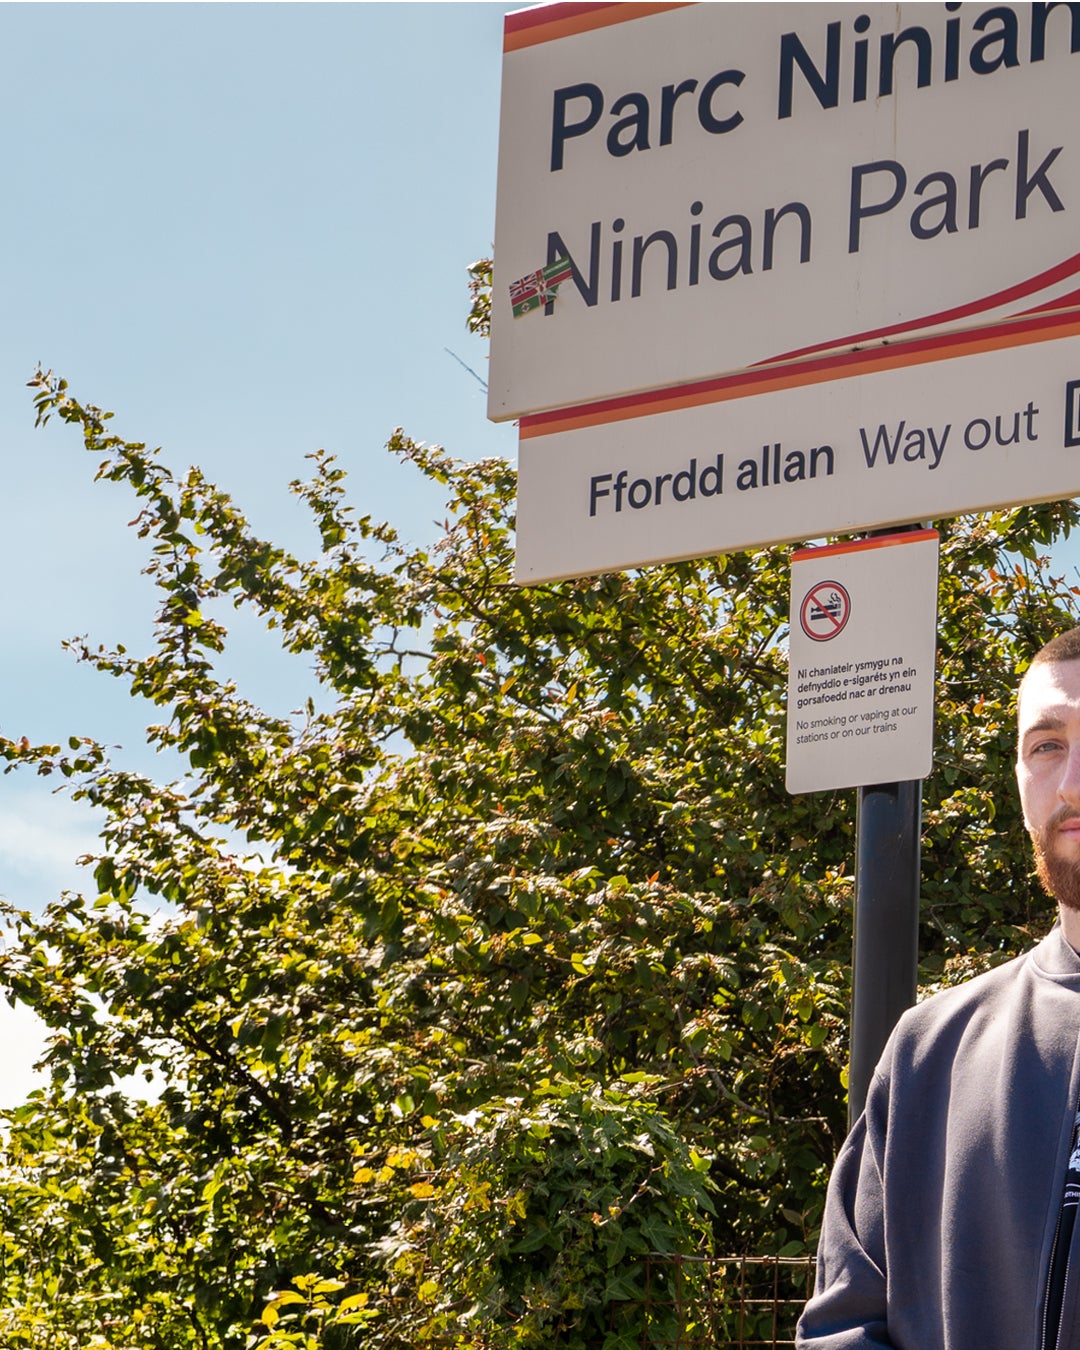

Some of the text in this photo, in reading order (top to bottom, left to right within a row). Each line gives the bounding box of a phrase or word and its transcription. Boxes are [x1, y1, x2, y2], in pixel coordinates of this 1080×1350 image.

[551, 69, 746, 172] Parc
[545, 129, 1065, 316] Ninian Park
[860, 402, 1039, 470] Way out
[590, 443, 834, 516] Ffordd allan
[797, 656, 904, 680] Ni chaniateir ysmygu na
[797, 678, 842, 694] defnyddio
[888, 670, 901, 683] yn
[902, 667, 917, 678] ein
[796, 683, 912, 710] gorsafoedd nac ar drenau
[796, 705, 918, 731] No smoking or vaping at our
[796, 722, 898, 745] stations or on our trains
